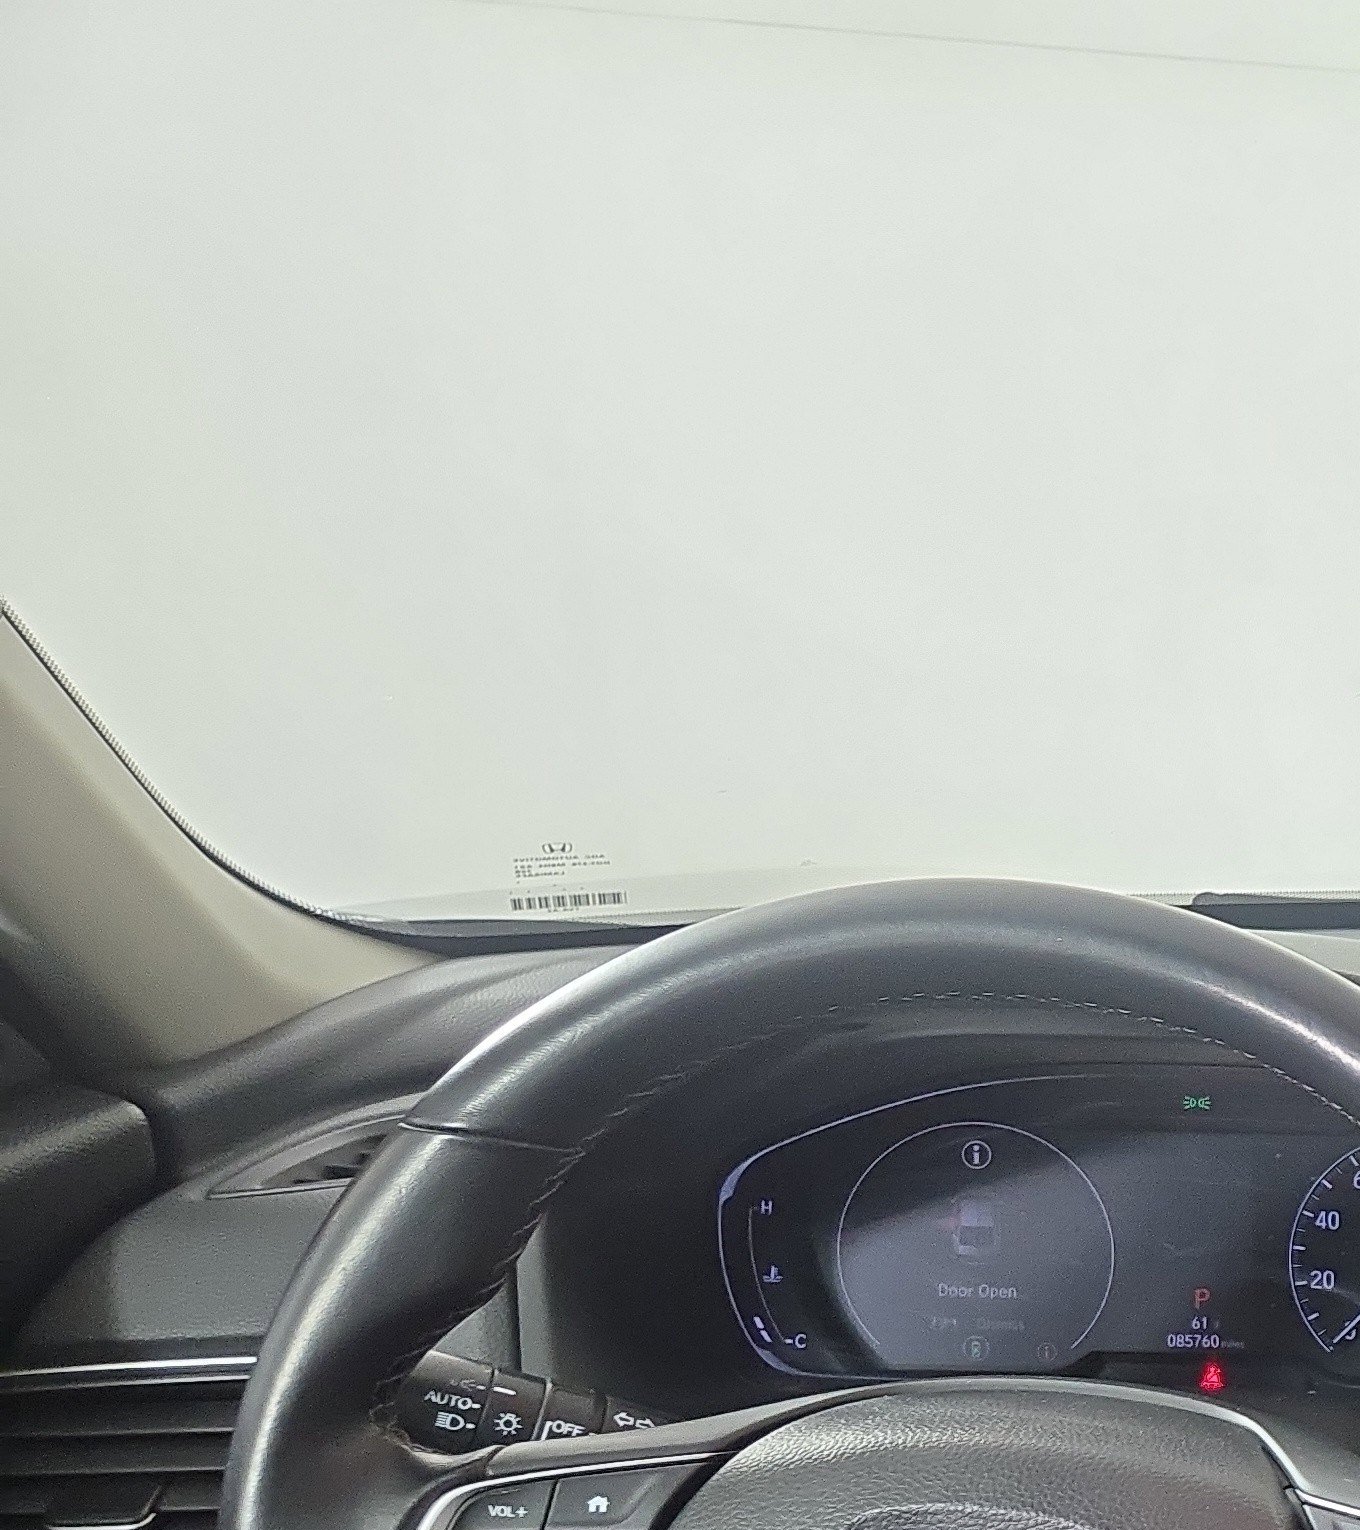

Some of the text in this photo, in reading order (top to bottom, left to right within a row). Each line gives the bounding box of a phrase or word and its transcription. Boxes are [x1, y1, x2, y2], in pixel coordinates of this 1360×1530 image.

[760, 1201, 773, 1215] H
[1314, 1211, 1340, 1230] 40
[1310, 1271, 1335, 1290] 20
[938, 1283, 1017, 1299] Door Open
[1194, 1288, 1211, 1310] P
[1192, 1315, 1208, 1330] 61
[794, 1334, 807, 1349] C
[1167, 1334, 1220, 1348] 085760
[424, 1390, 474, 1411] AUTO
[552, 1420, 585, 1437] OFF
